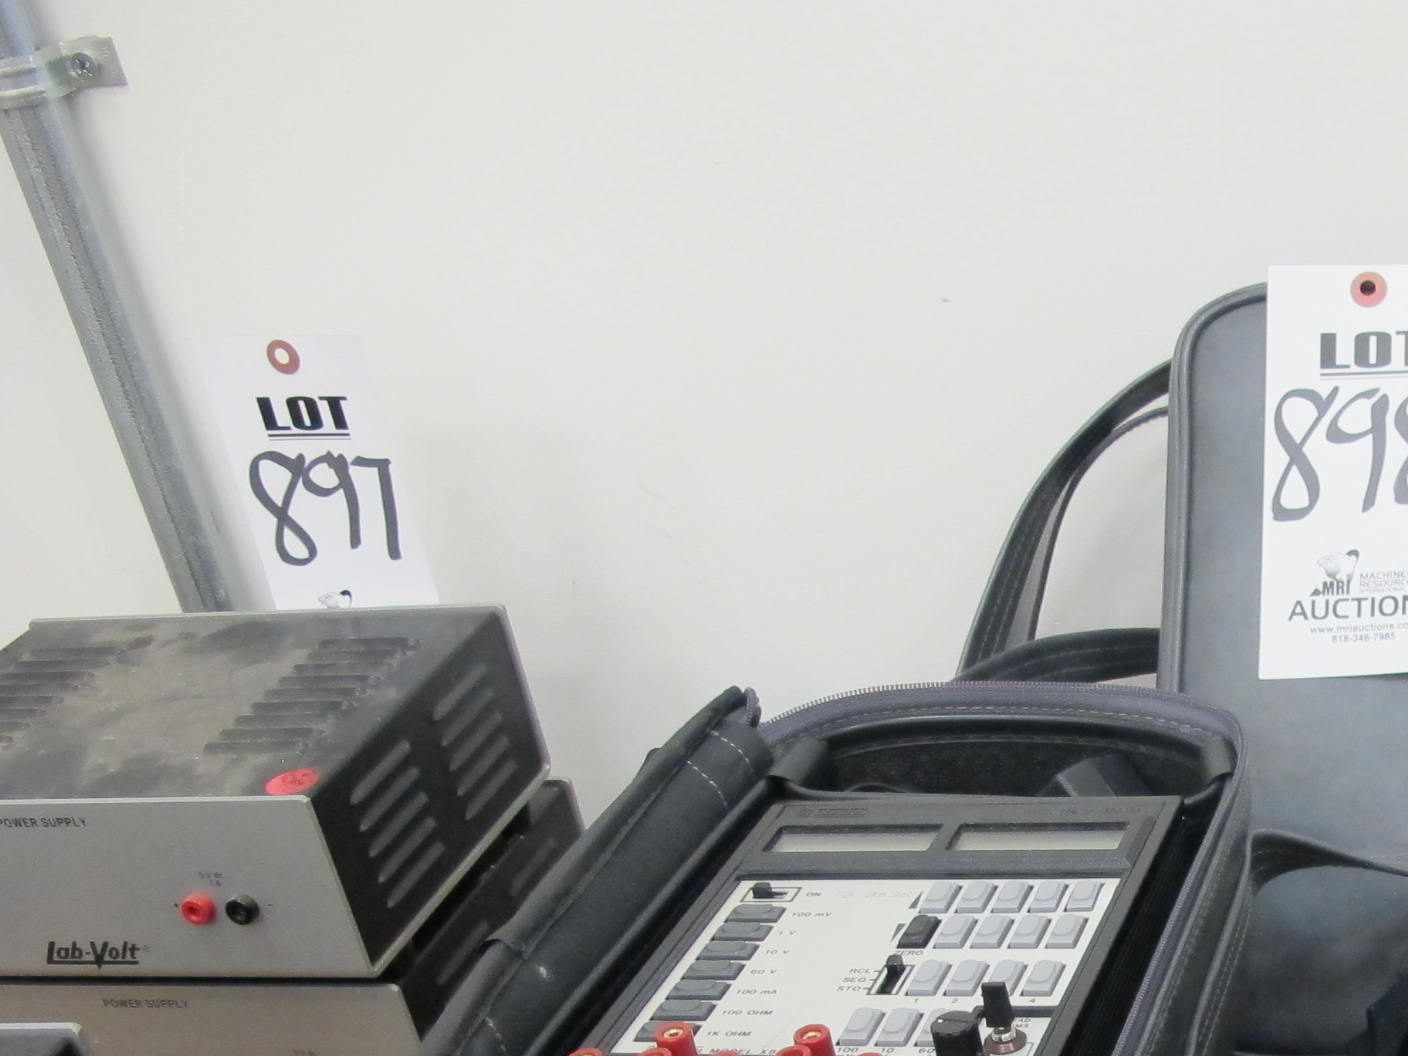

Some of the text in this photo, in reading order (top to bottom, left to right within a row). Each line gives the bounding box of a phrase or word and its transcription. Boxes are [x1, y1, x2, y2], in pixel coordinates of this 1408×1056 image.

[256, 396, 348, 431] LOT
[249, 450, 402, 566] 897
[1321, 574, 1351, 596] MRI
[40, 817, 87, 829] SUPPLY
[47, 940, 140, 969] Lab-Volt
[103, 999, 188, 1009] POWER SUPPLY
